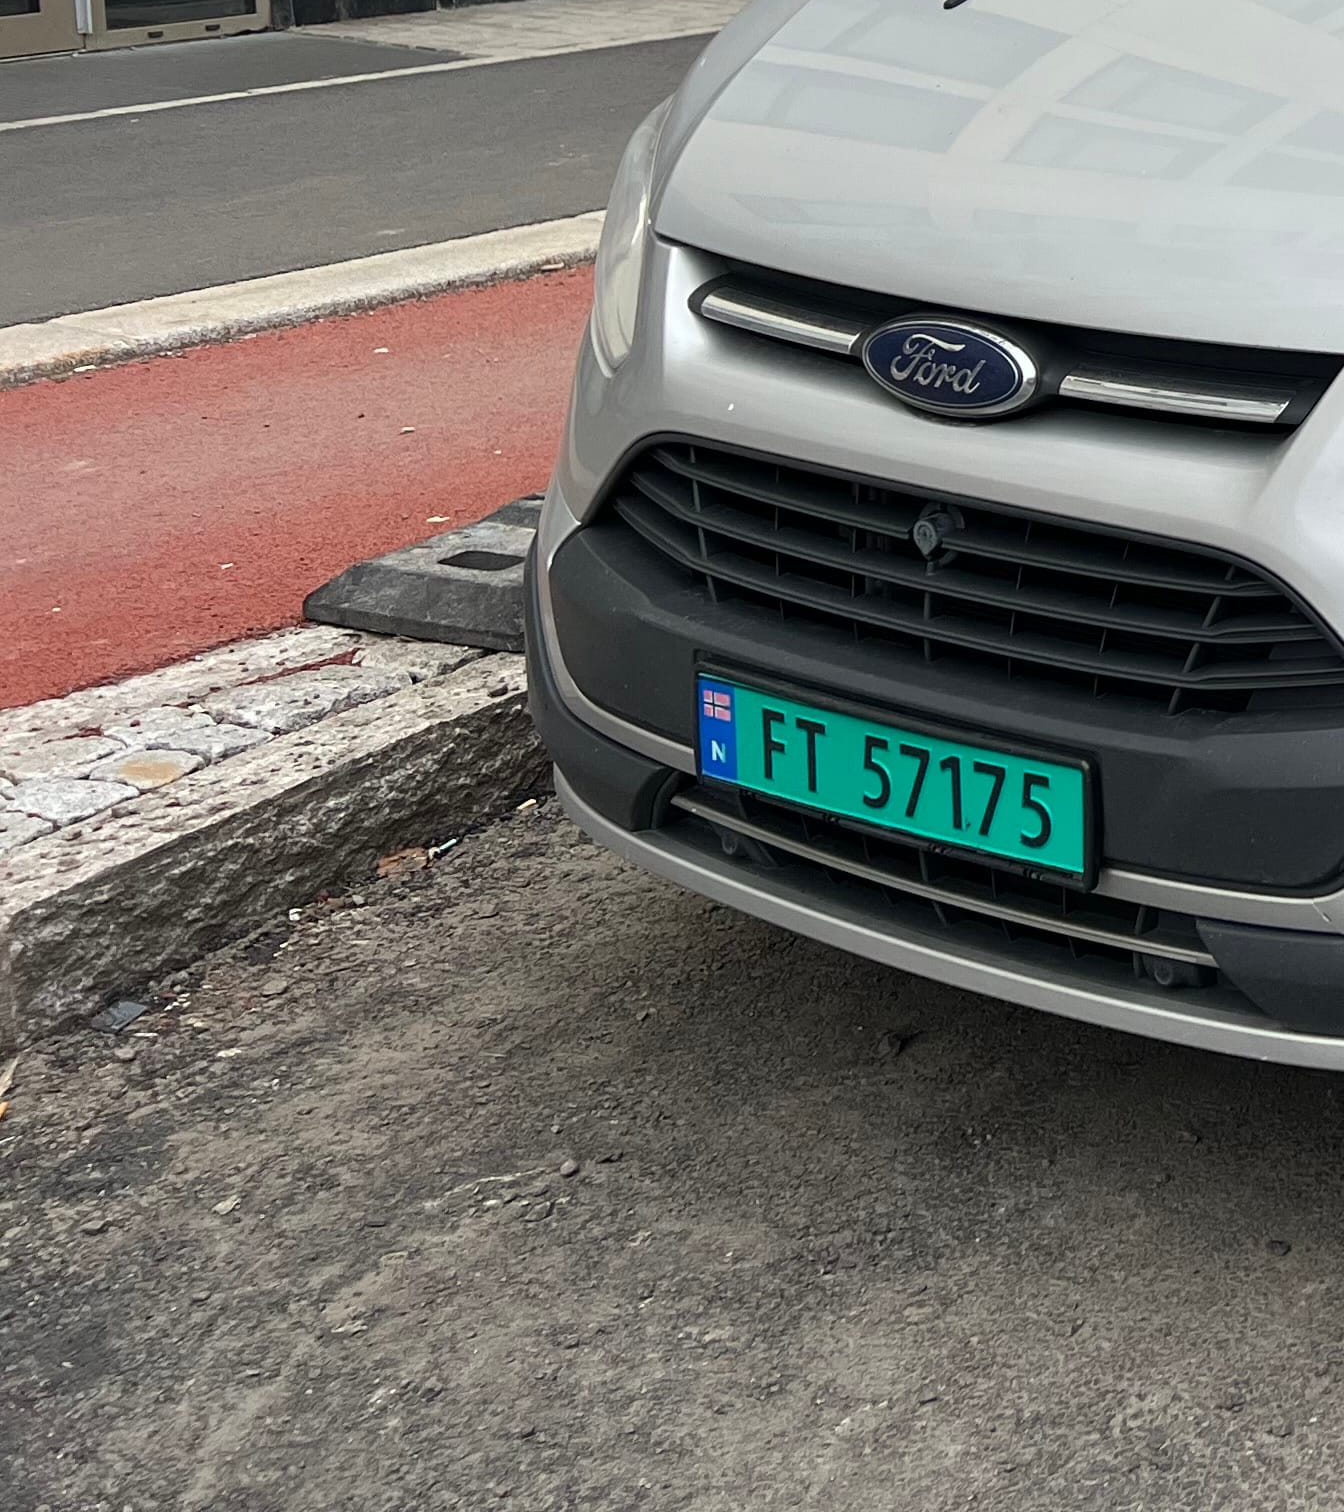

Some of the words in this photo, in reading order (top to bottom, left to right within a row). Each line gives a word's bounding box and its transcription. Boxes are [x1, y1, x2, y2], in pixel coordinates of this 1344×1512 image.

[890, 333, 986, 394] Ford
[711, 740, 727, 764] N
[761, 708, 826, 792] FT
[862, 735, 1052, 848] 57175
